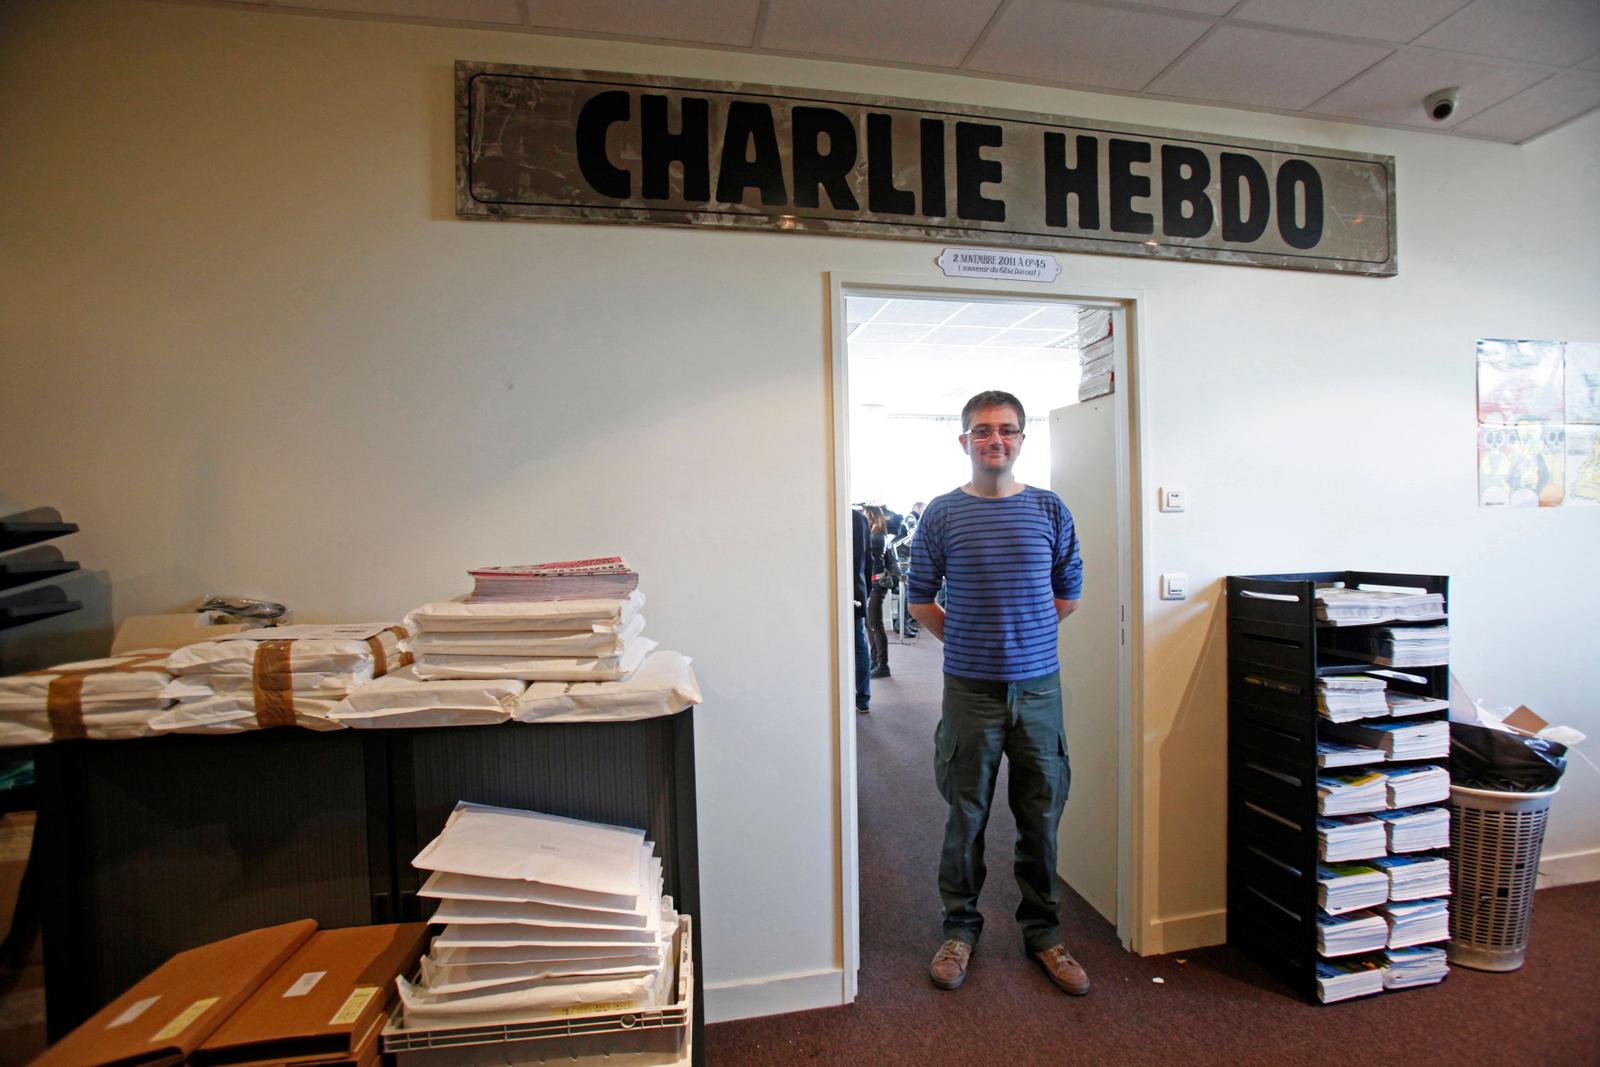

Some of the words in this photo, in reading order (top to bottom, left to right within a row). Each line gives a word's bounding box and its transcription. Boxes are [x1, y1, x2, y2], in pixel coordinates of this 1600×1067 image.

[576, 91, 1006, 223] CHARLIE
[1044, 131, 1324, 249] HEBDO
[953, 253, 959, 262] 2
[960, 254, 997, 265] NOVEMBRE
[998, 256, 1016, 266] 2011
